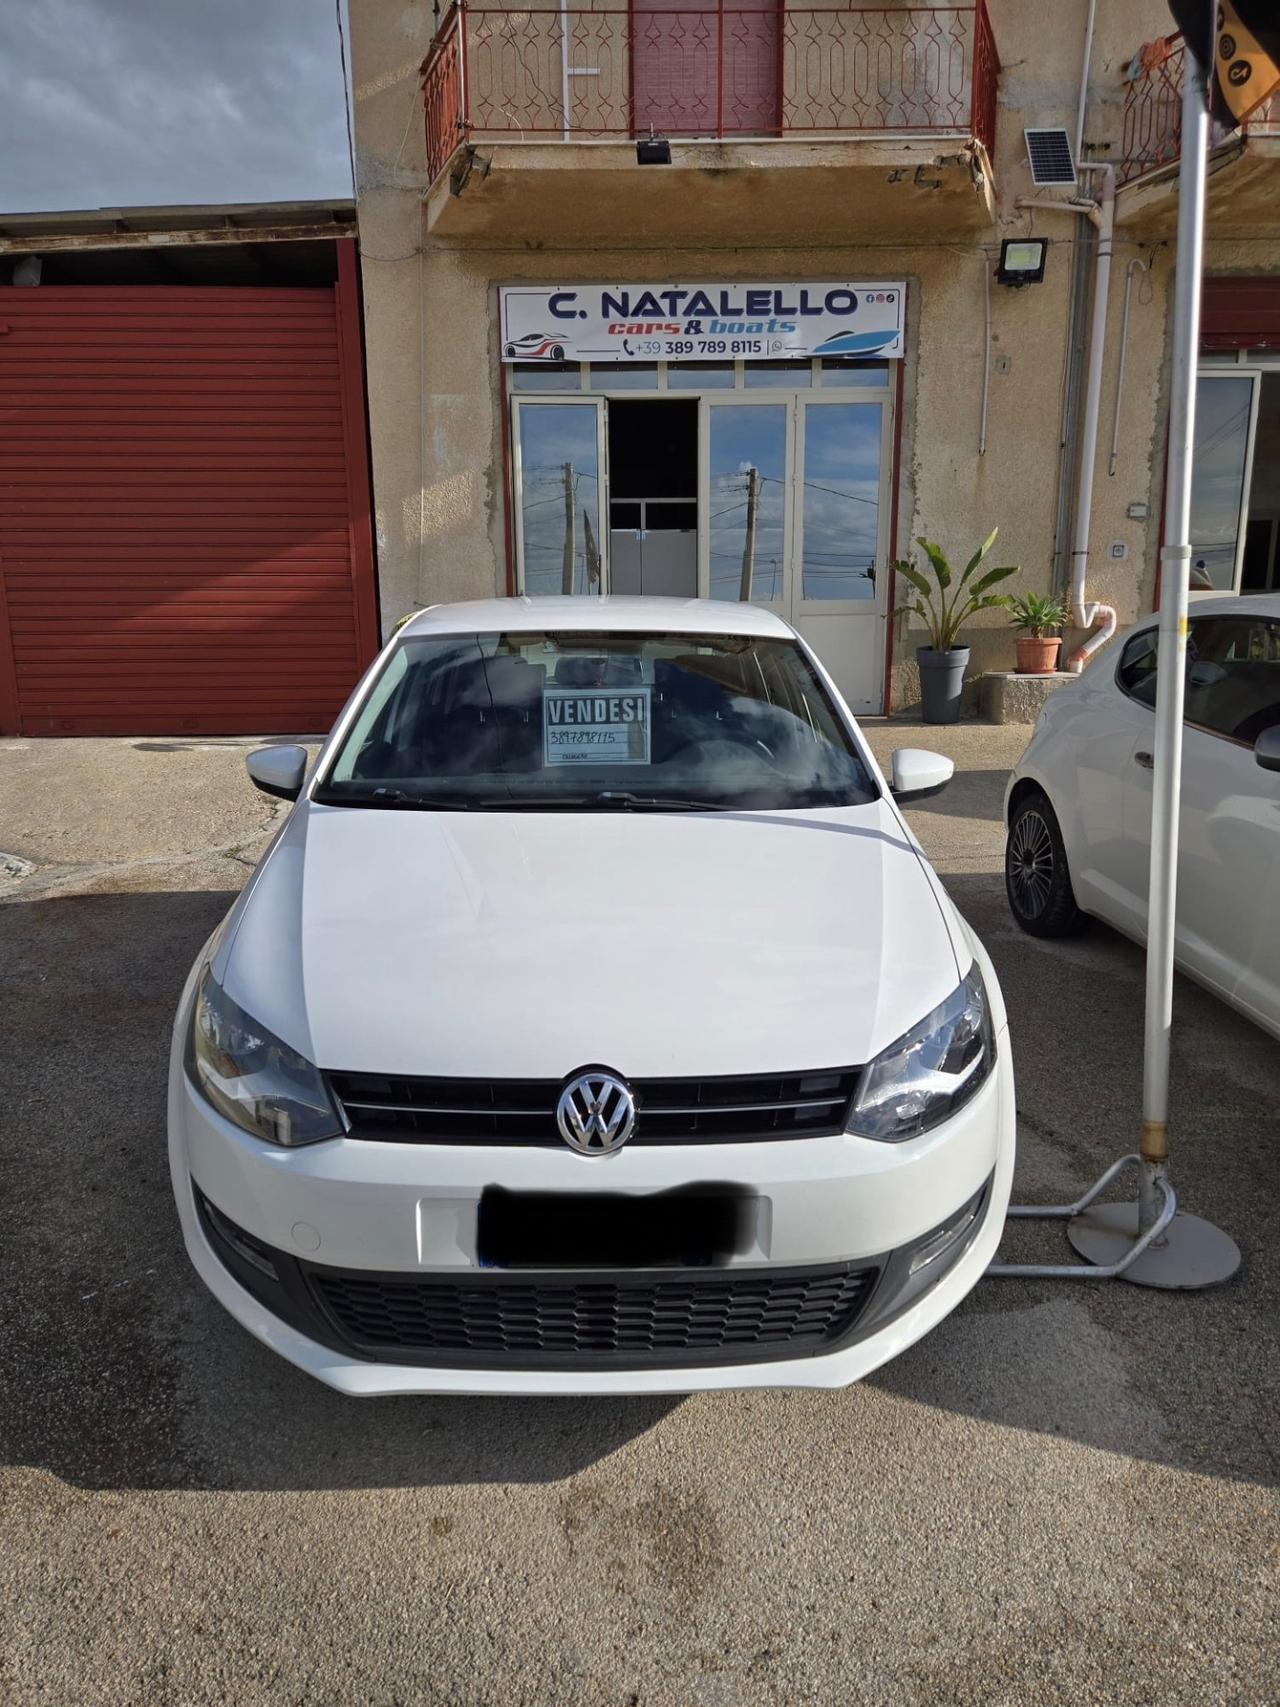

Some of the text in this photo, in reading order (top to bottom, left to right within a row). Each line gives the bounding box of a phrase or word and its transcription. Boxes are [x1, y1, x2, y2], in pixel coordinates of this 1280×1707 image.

[548, 289, 858, 319] C. NATALELLO
[608, 318, 798, 335] cars & boats
[635, 340, 762, 354] +39 389 789 8115
[548, 698, 643, 723] VENDESI
[563, 1080, 629, 1148] VW
